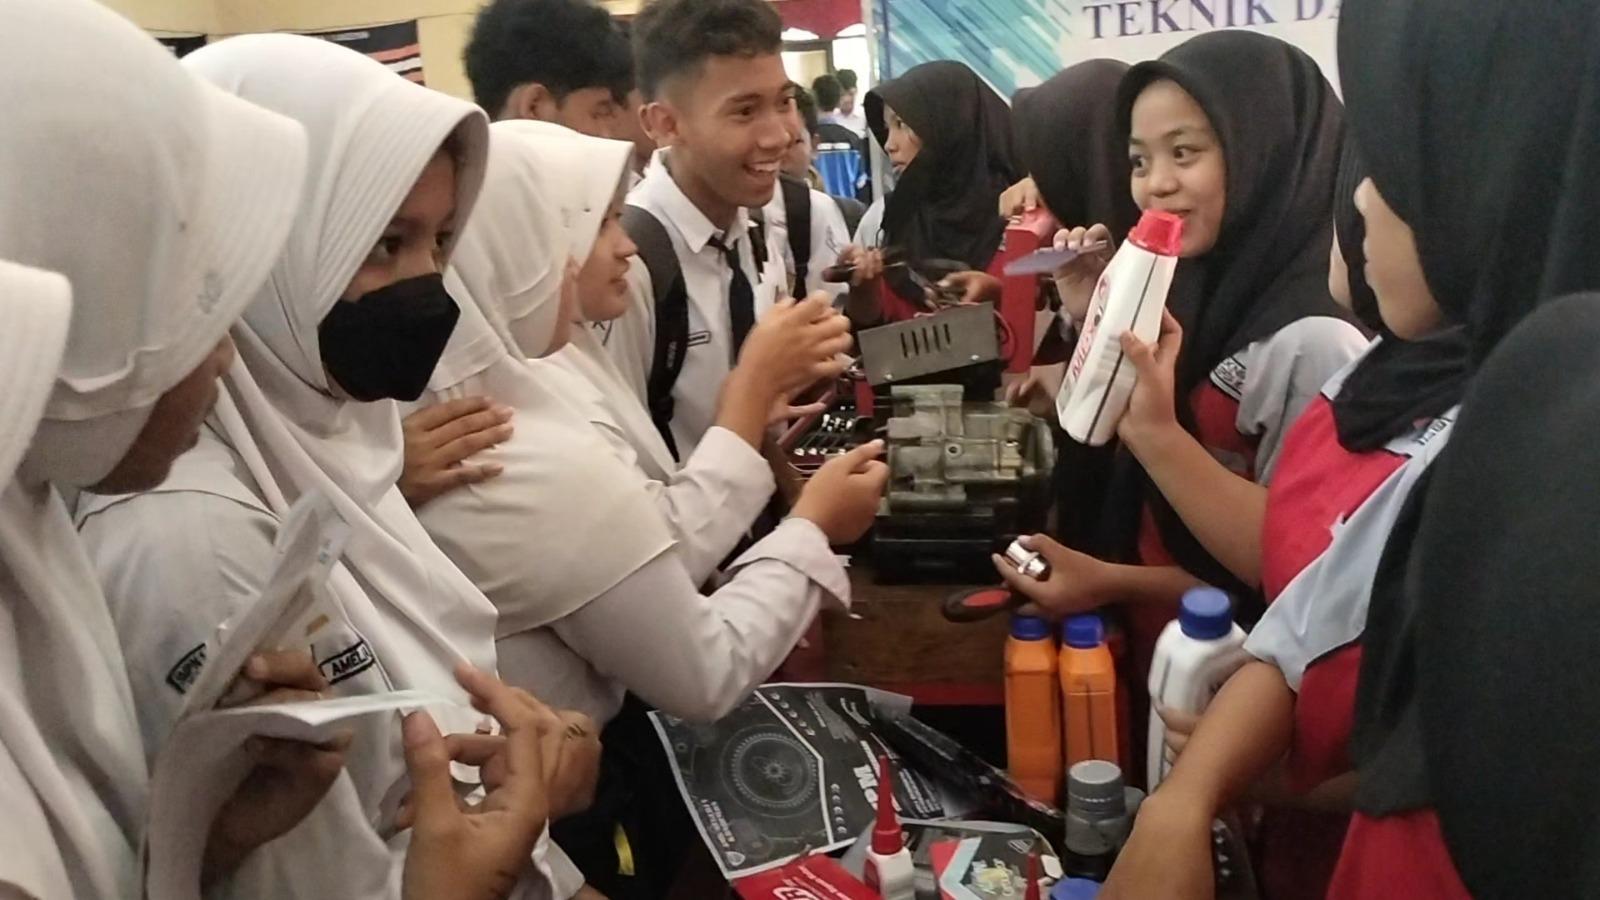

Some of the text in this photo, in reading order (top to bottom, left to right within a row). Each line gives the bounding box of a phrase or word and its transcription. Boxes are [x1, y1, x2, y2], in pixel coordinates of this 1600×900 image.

[1082, 0, 1340, 39] TEKNIK D
[852, 764, 879, 811] PM
